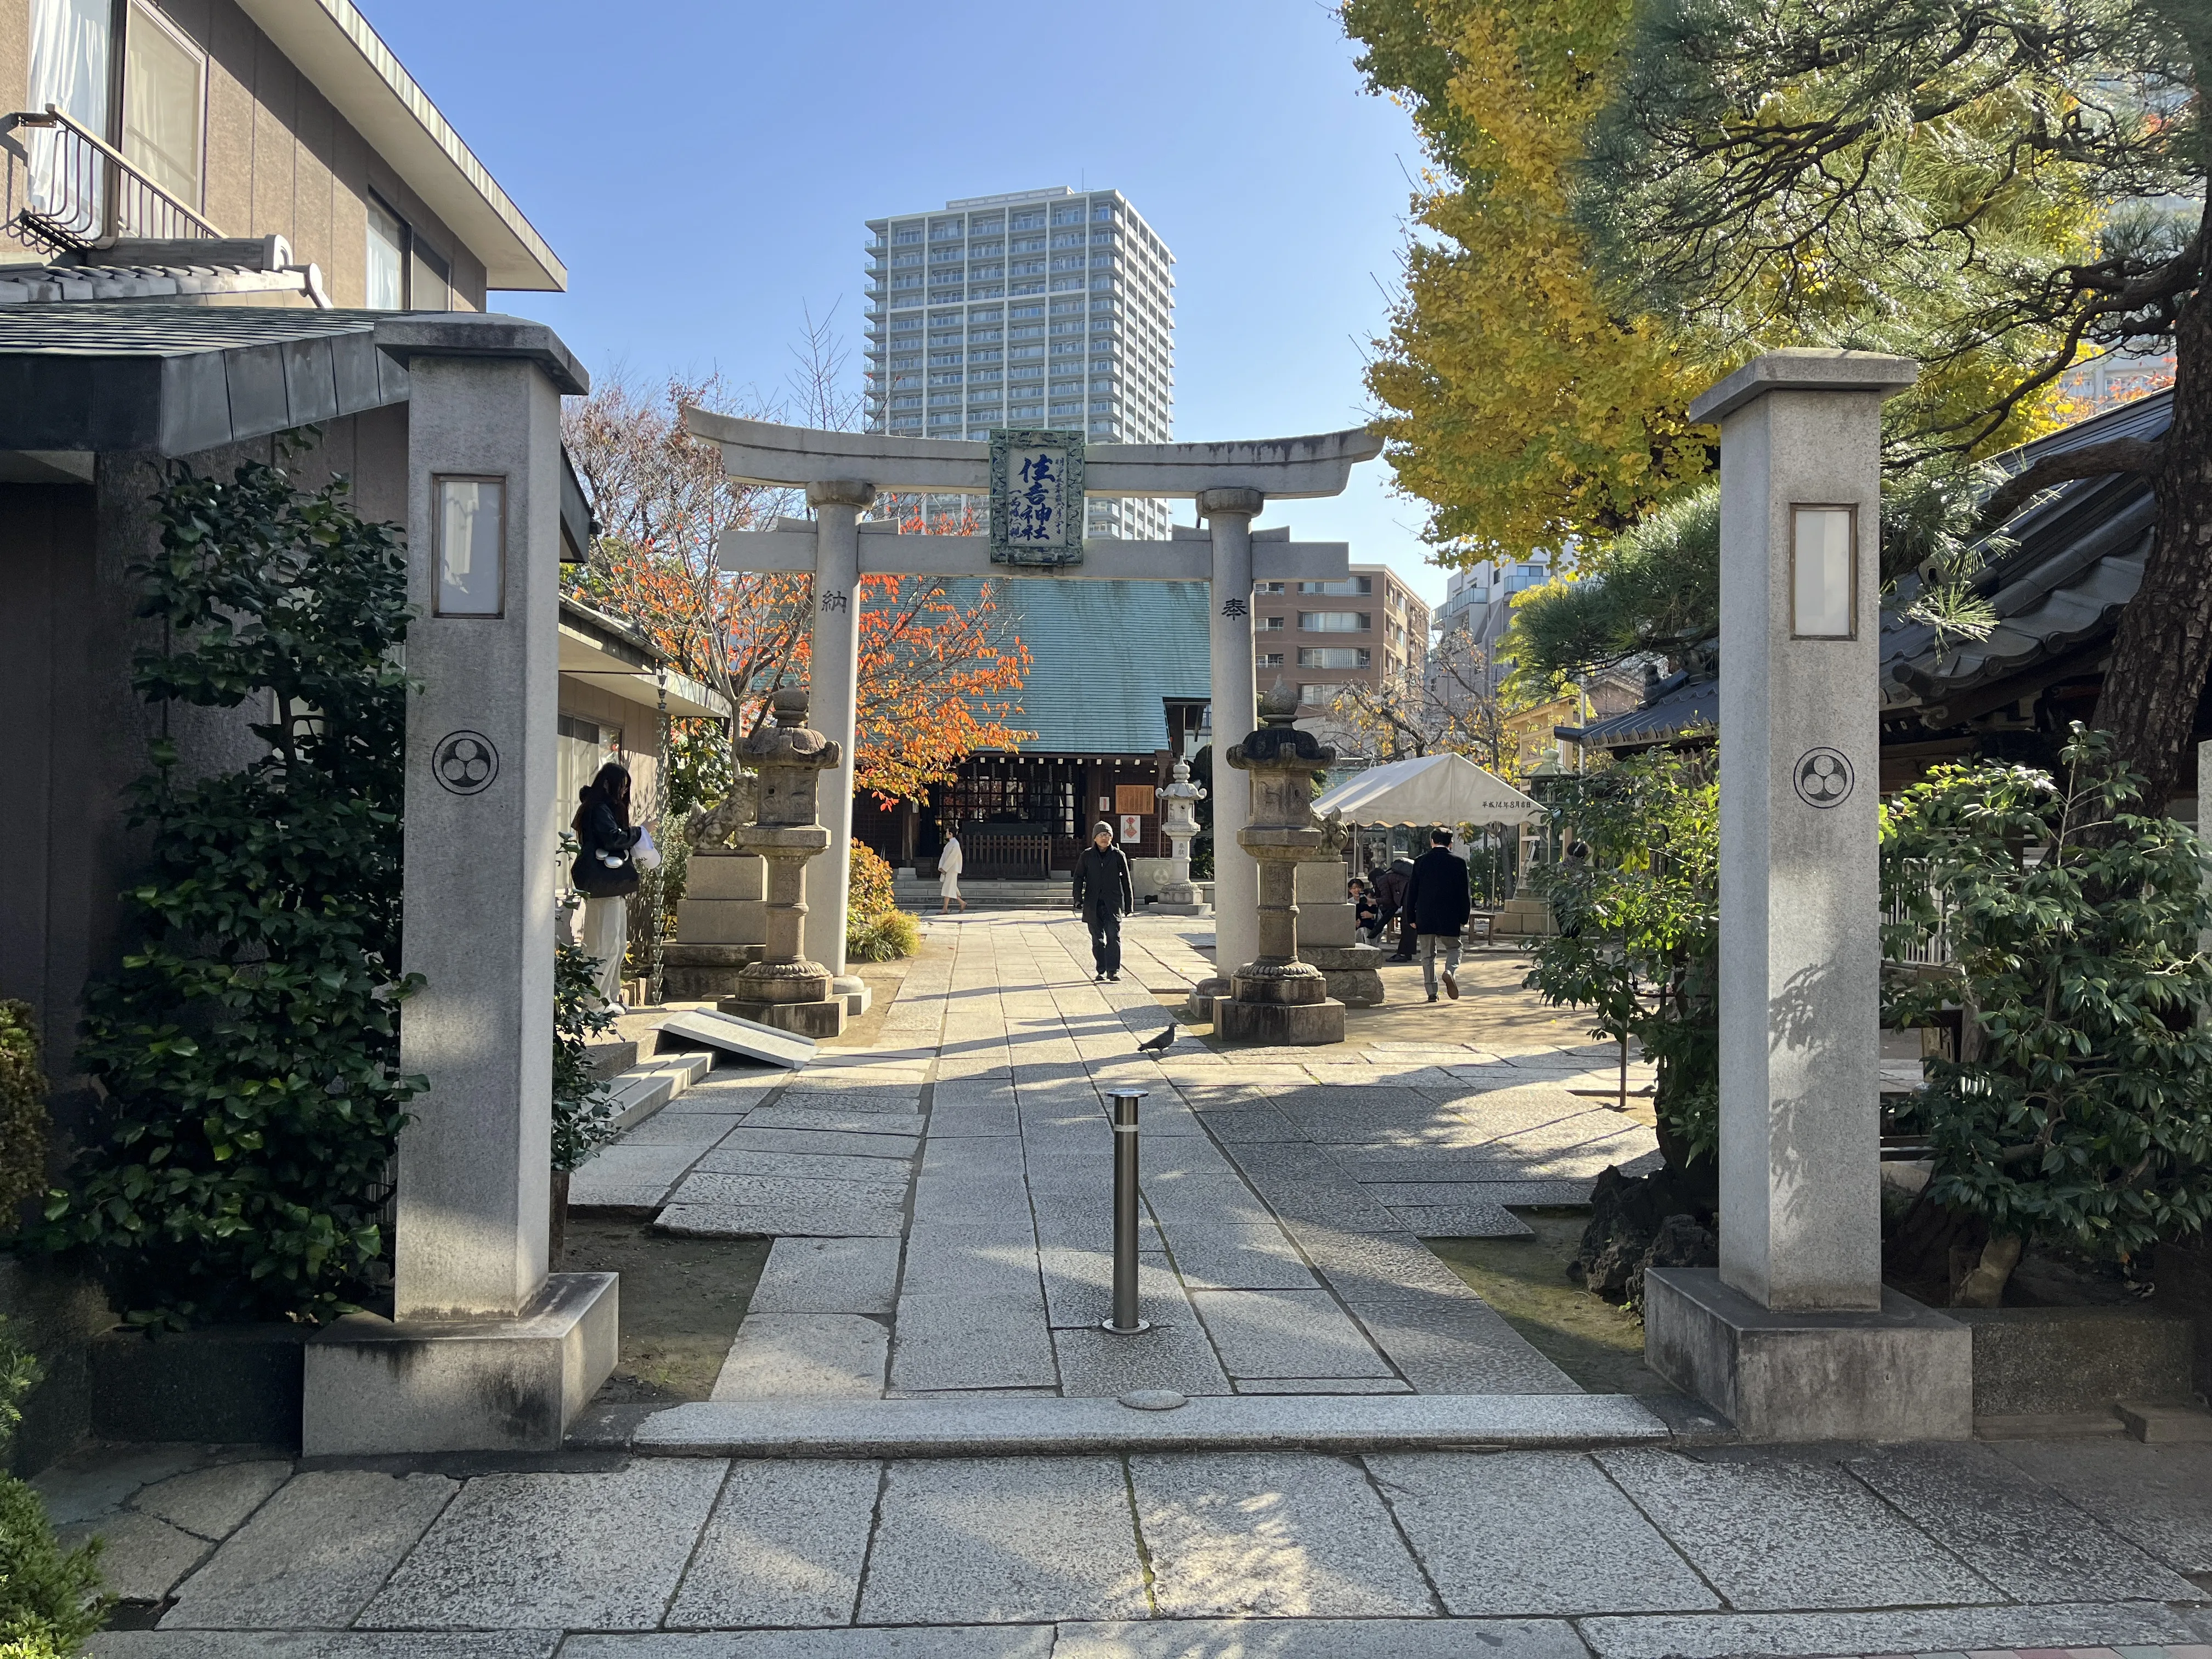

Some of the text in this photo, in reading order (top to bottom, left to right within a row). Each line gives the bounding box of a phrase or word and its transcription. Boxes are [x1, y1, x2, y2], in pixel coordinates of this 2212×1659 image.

[1018, 454, 1056, 541] 住吉神社
[821, 590, 847, 613] 納
[1221, 598, 1248, 620] 奉
